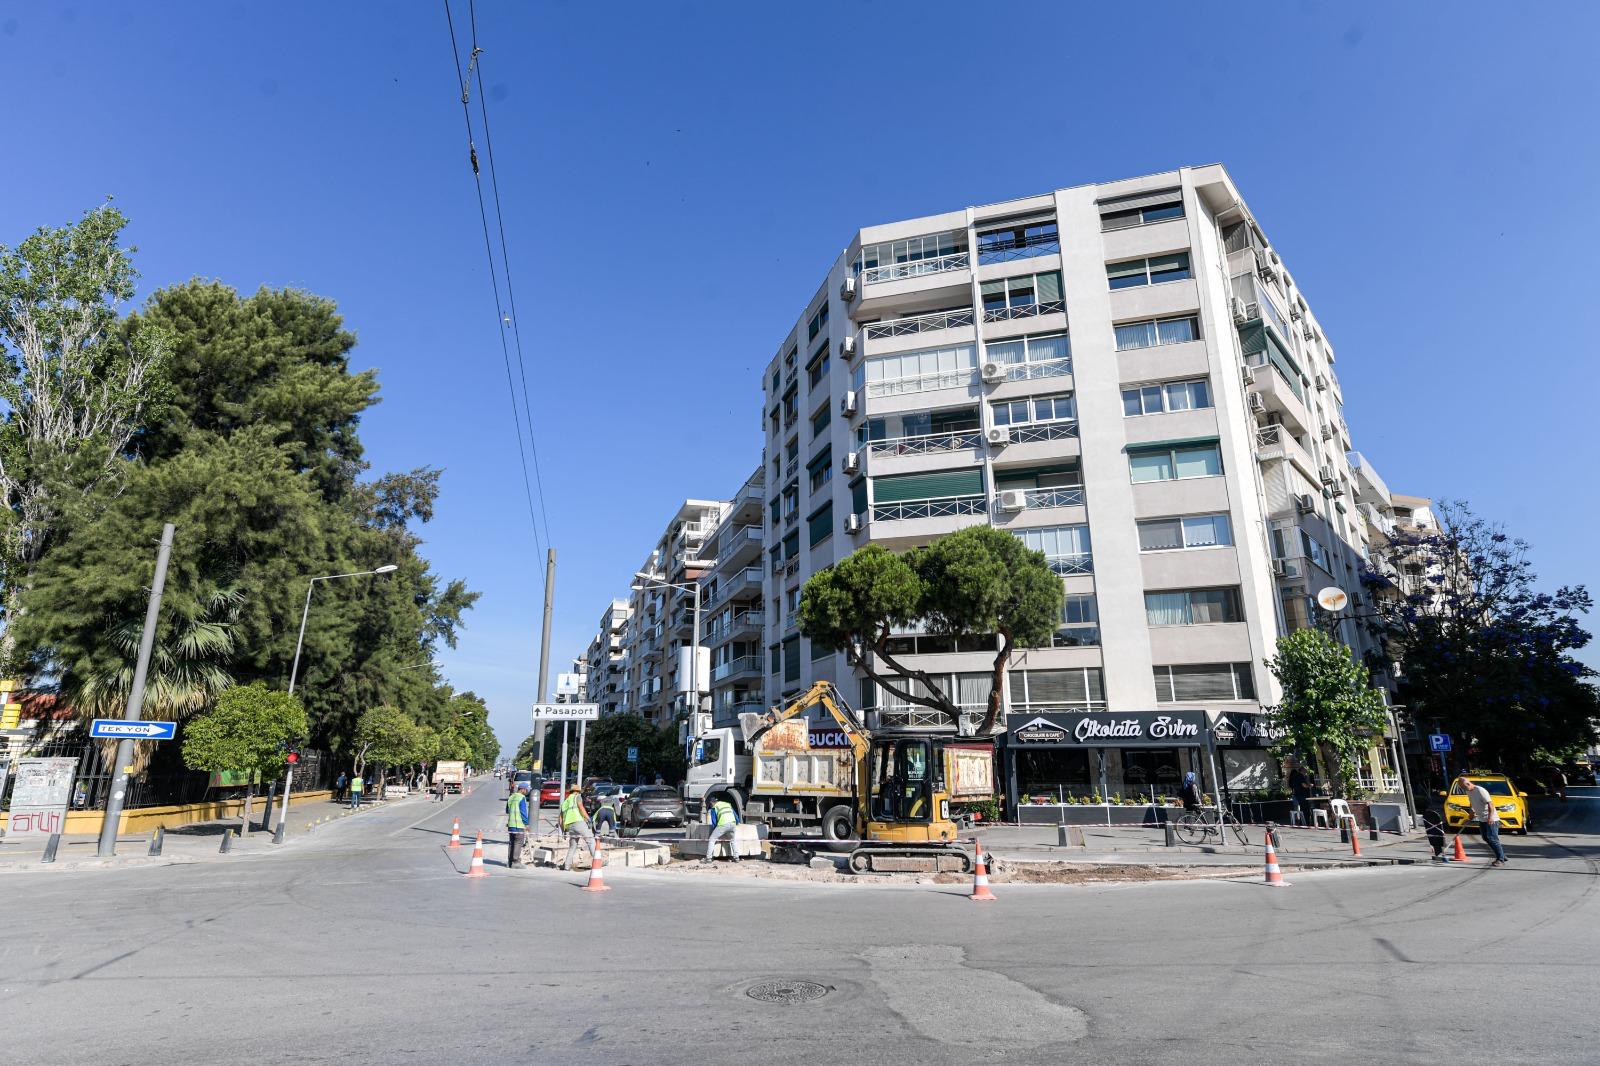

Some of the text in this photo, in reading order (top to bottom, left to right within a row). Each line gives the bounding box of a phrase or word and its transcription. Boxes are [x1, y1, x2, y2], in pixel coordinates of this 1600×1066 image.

[545, 706, 593, 717] Pasaport
[1149, 716, 1198, 738] Evim
[1432, 736, 1443, 749] P
